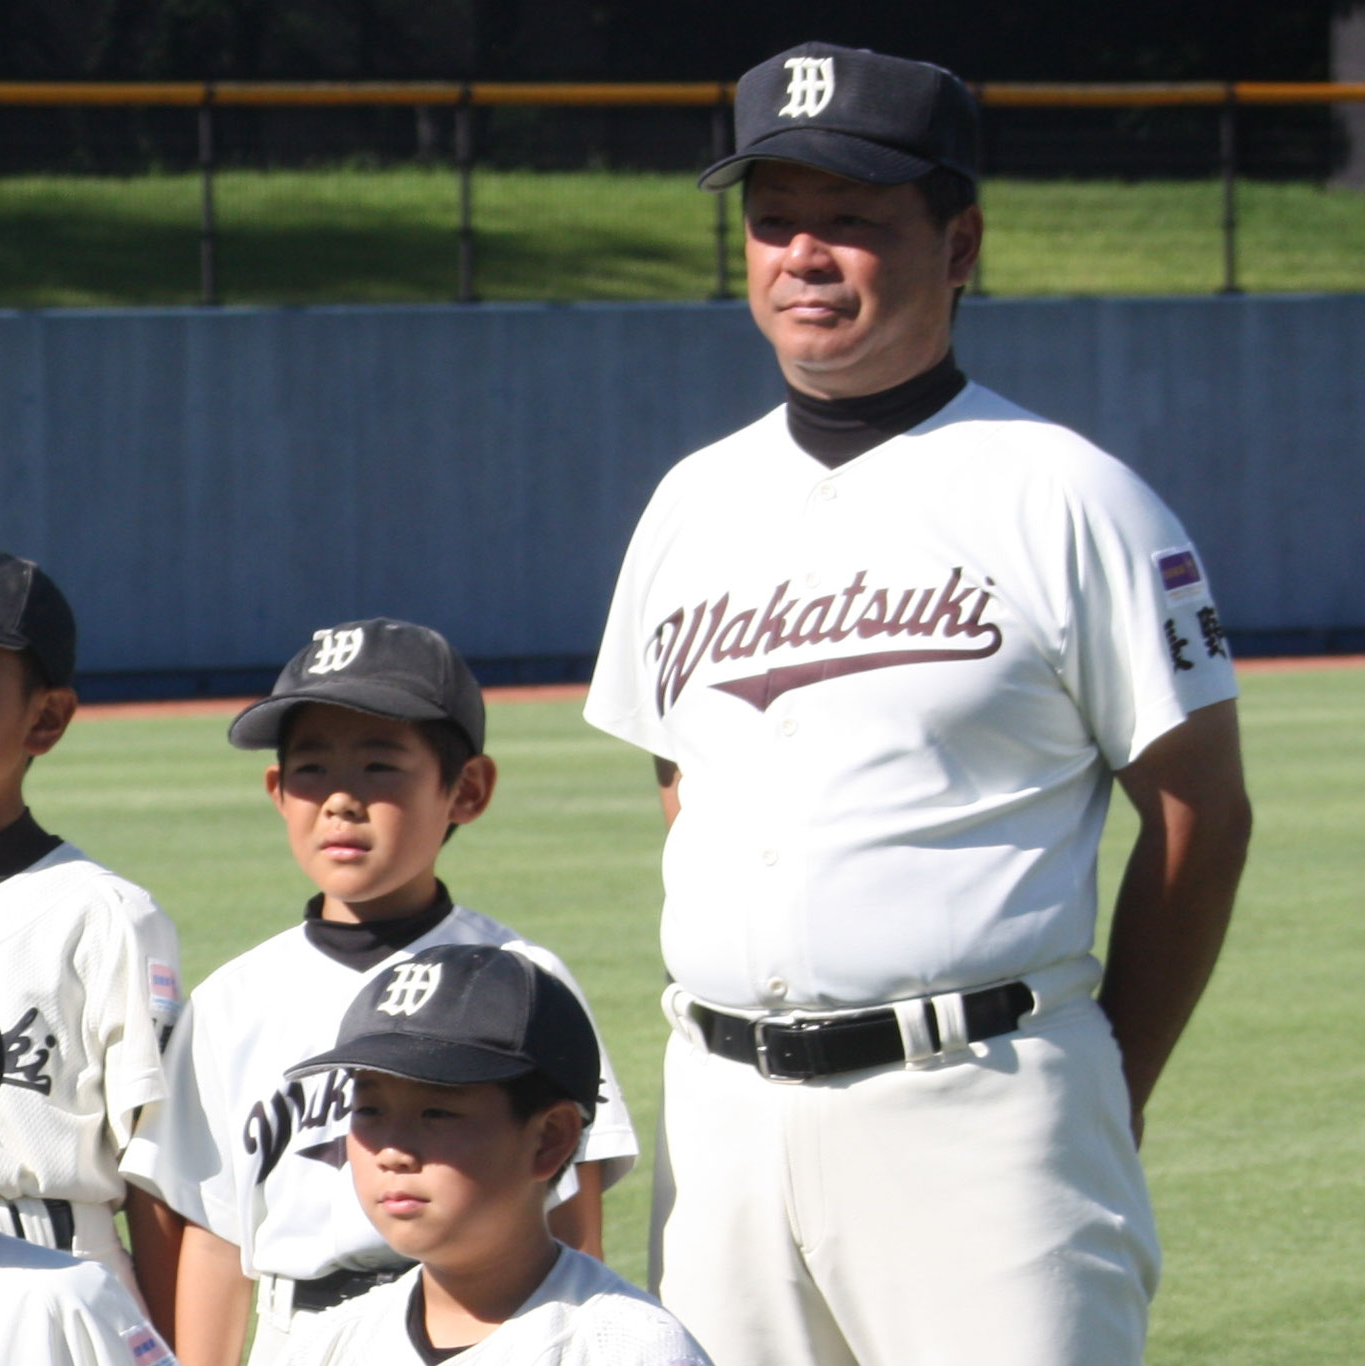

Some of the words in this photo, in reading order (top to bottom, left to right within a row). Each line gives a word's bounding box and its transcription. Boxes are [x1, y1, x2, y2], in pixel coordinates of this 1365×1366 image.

[779, 56, 835, 118] W
[307, 626, 364, 675] W
[655, 566, 1002, 720] Wakatsuki
[377, 962, 442, 1017] W
